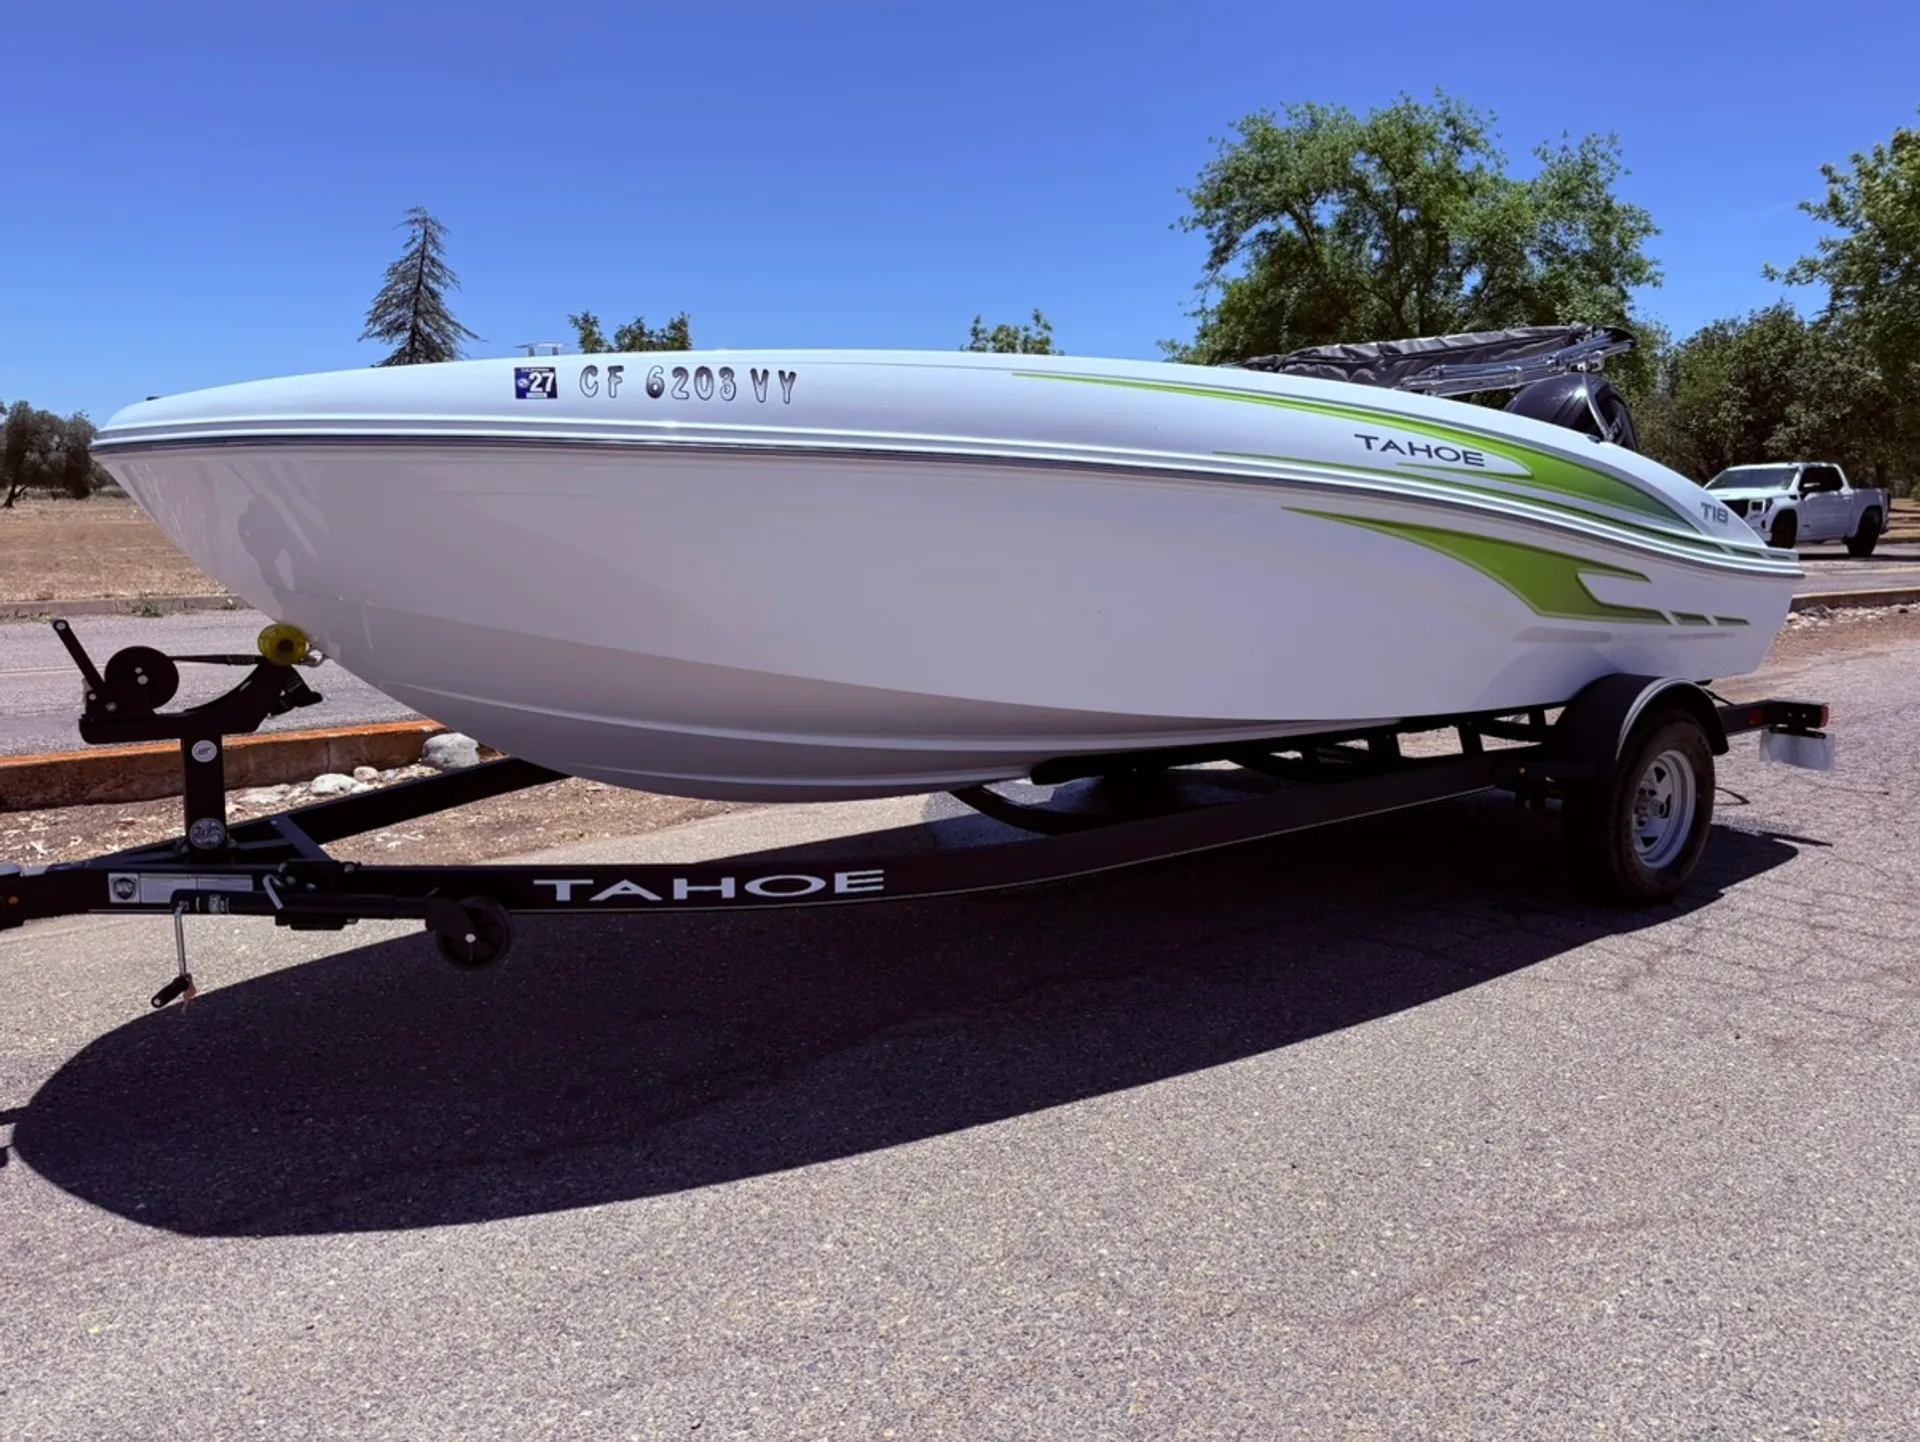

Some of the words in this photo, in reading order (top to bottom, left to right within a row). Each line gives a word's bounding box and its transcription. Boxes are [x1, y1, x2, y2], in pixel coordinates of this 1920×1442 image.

[529, 371, 554, 392] 27
[578, 364, 625, 399] CF
[645, 364, 737, 402] 6203
[749, 367, 798, 405] VY
[1354, 433, 1486, 468] TAHOE
[533, 869, 885, 902] TAHOE
